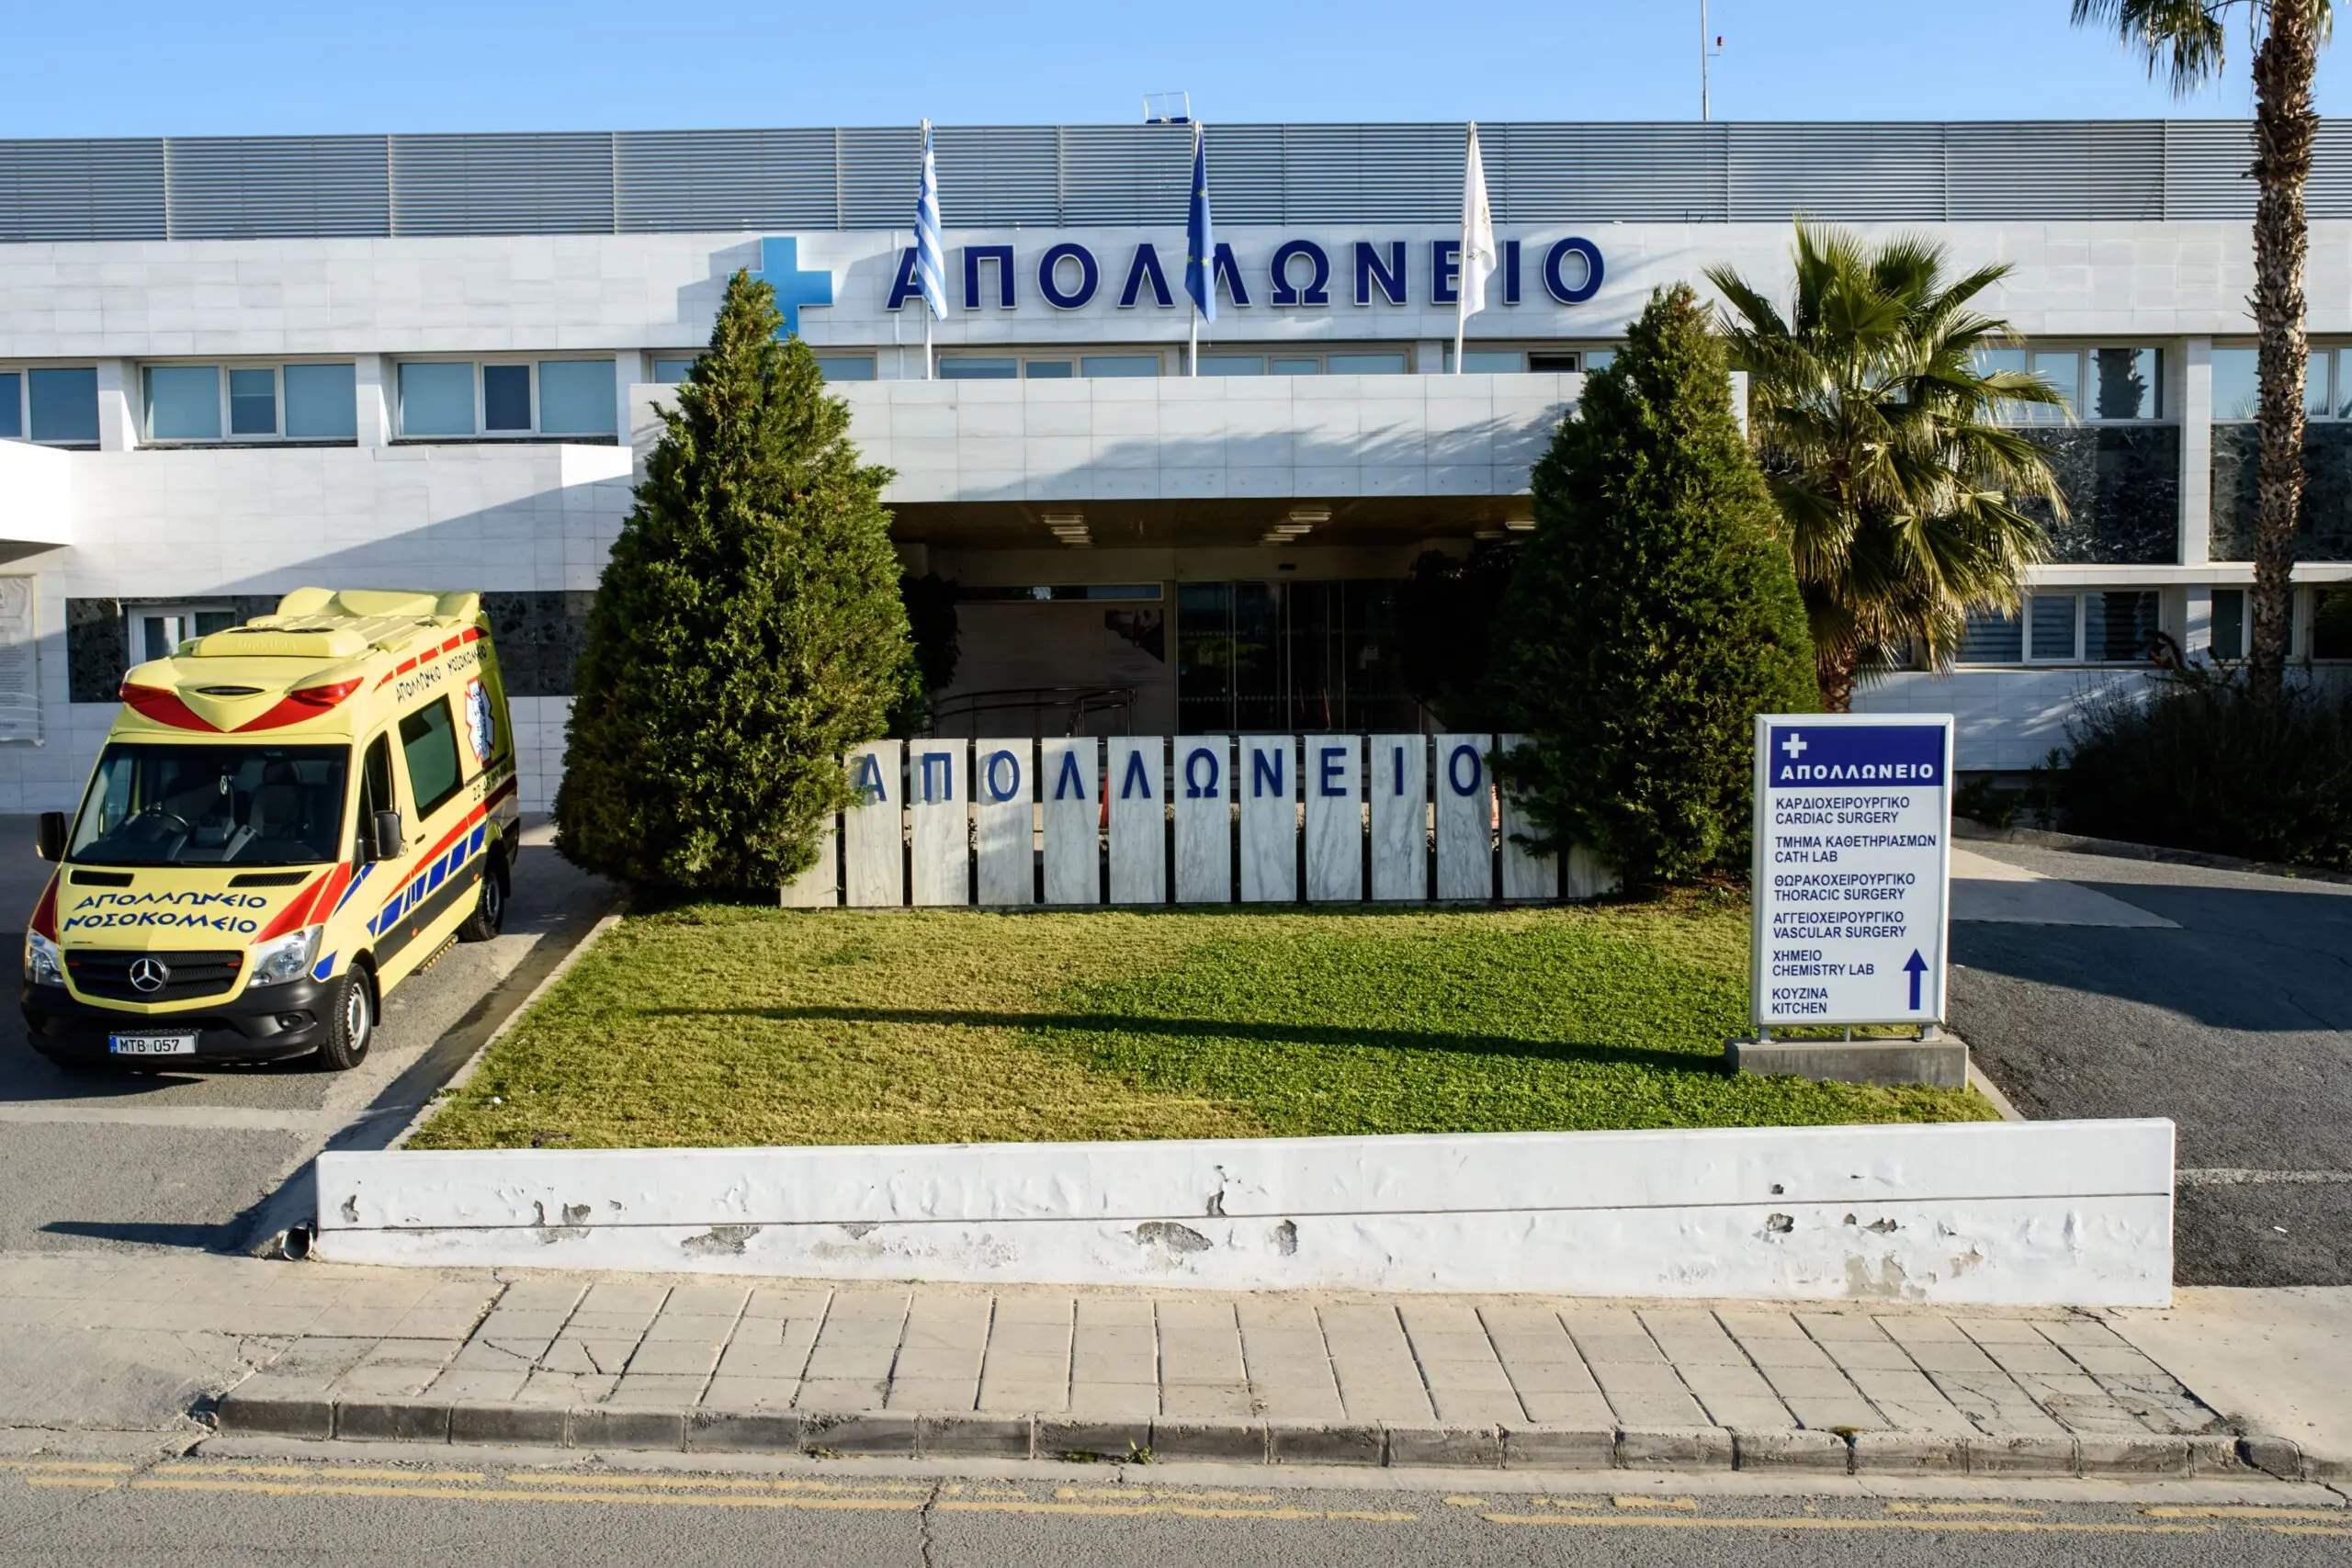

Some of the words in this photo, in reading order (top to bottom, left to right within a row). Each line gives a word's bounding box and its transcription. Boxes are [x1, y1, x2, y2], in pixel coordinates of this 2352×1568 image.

[886, 237, 1606, 312] ΑΠΟΛΛΩΝΕΙΟ
[1781, 763, 1934, 780] ΑΠΟΛΛΩΝΕΙΟ
[1776, 796, 1910, 810] ΚΑΡΔΙΟΧΕΙΡΟΥΡΓΙΚΟ
[1775, 811, 1834, 825] CARDIAC
[1837, 811, 1899, 824] SURGERY
[1775, 836, 1822, 848] ΤΜΗΜΑ
[1826, 834, 1937, 848] ΚΑΘΕΤΗΡΙΑΣΜΩΝ
[1774, 851, 1809, 863] CATH
[1813, 851, 1838, 863] LAB
[1774, 873, 1916, 886] ΘΩΡΑΚΟΧΕΙΡΟΥΡΓΙΚΟ
[73, 891, 267, 911] ΑΠΟΛΛΩΝΕΙΟ
[1774, 888, 1840, 901] THORACIC
[1843, 887, 1905, 901] SURGERY
[63, 911, 257, 933] ΝΟΣΟΚΟΜΕΙΟ
[1773, 910, 1905, 924] ΑΓΓΕΙΟΧΕΙΡΟΥΡΓΙΚΟ
[1773, 926, 1842, 939] VASCULAR
[1845, 925, 1906, 939] SURGERY
[1772, 949, 1823, 962] ΧΗΜΕΙΟ
[1772, 964, 1846, 976] CHEMISTRY
[1849, 963, 1874, 976] LAB
[1772, 987, 1828, 1000] ΚΟΥΖΙΝΑ
[1771, 1002, 1827, 1015] KITCHEN
[119, 1039, 146, 1053] MTB
[153, 1039, 180, 1053] 057
